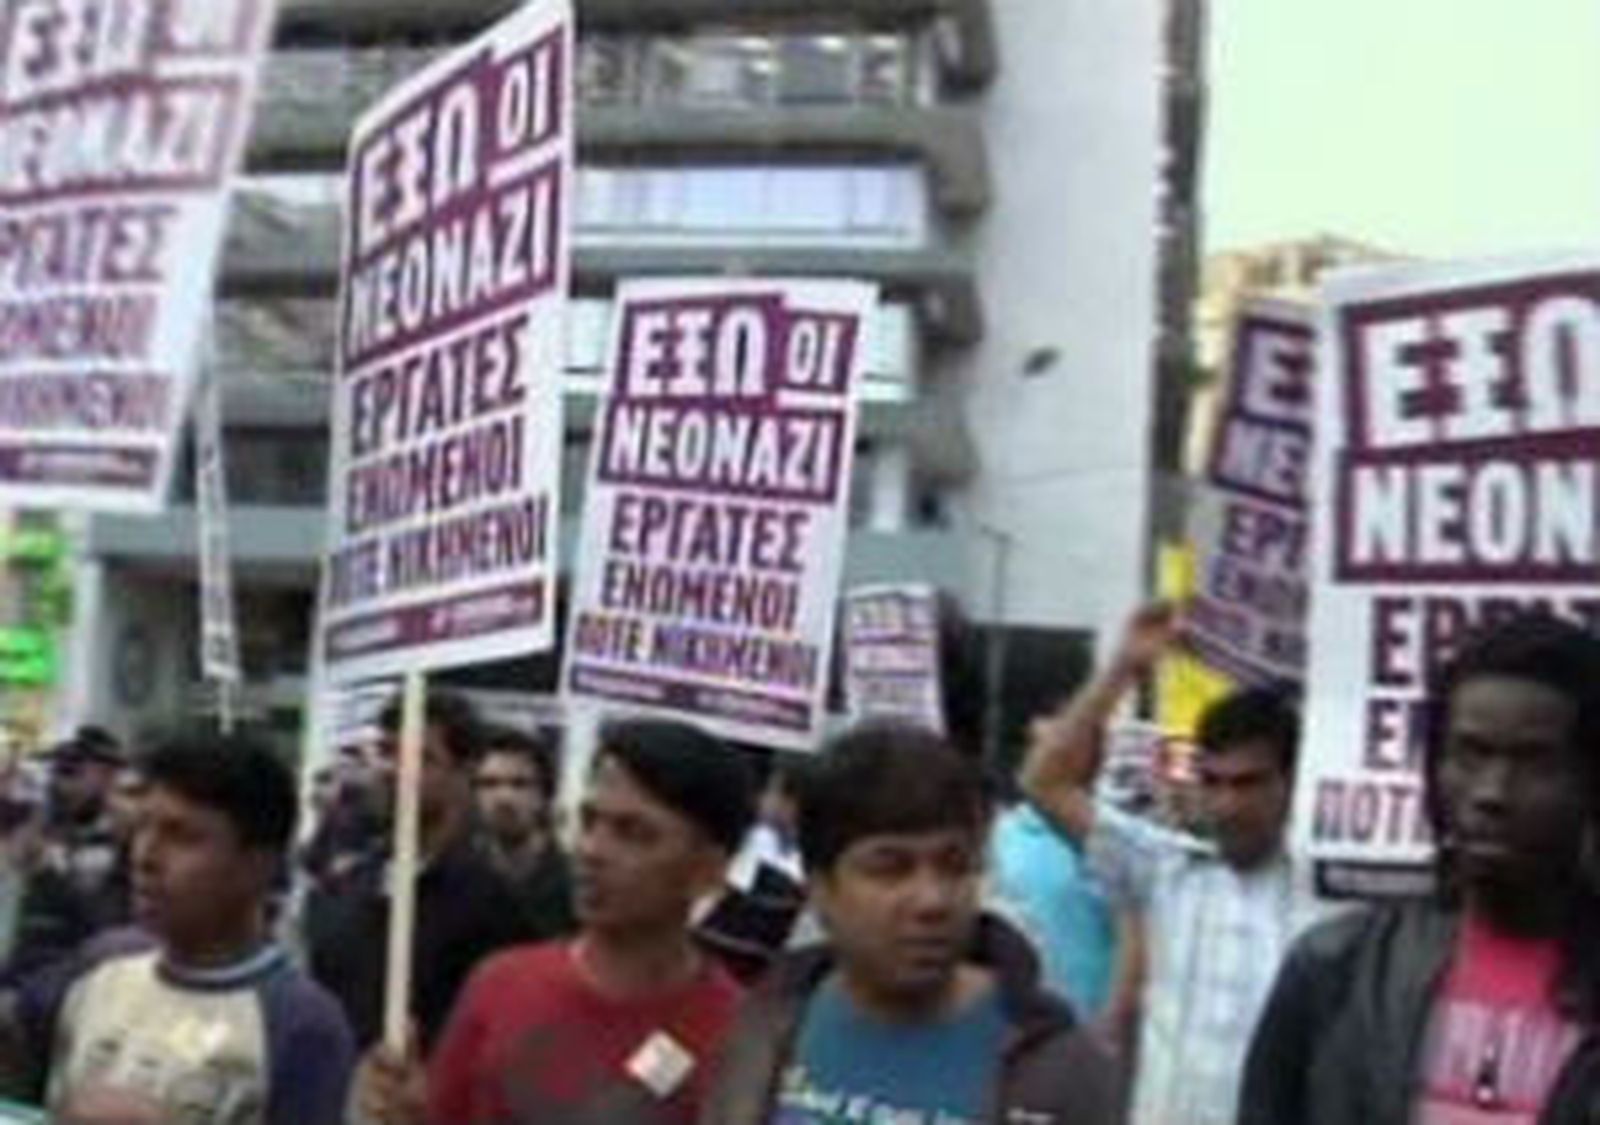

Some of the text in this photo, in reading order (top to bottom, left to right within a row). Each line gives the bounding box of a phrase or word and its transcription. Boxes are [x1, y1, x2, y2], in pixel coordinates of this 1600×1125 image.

[360, 48, 549, 250] ΕΞΩ ΟΙ
[351, 175, 551, 346] ΝΕΟΝΑΖΙ
[351, 317, 526, 460] ΕΡΓΑΤΕΣ
[627, 307, 846, 398] ΕΞΩ ΟΙ
[1362, 296, 1600, 448] ΕΞΩ
[607, 403, 838, 493] ΝΕΟΝΑΖΙ
[610, 495, 811, 572] ΕΡΓΑΤΕΣ
[1350, 460, 1597, 566] ΝΕΟΝ
[602, 559, 799, 632] ΕΝΩΜΕΝΟΙ
